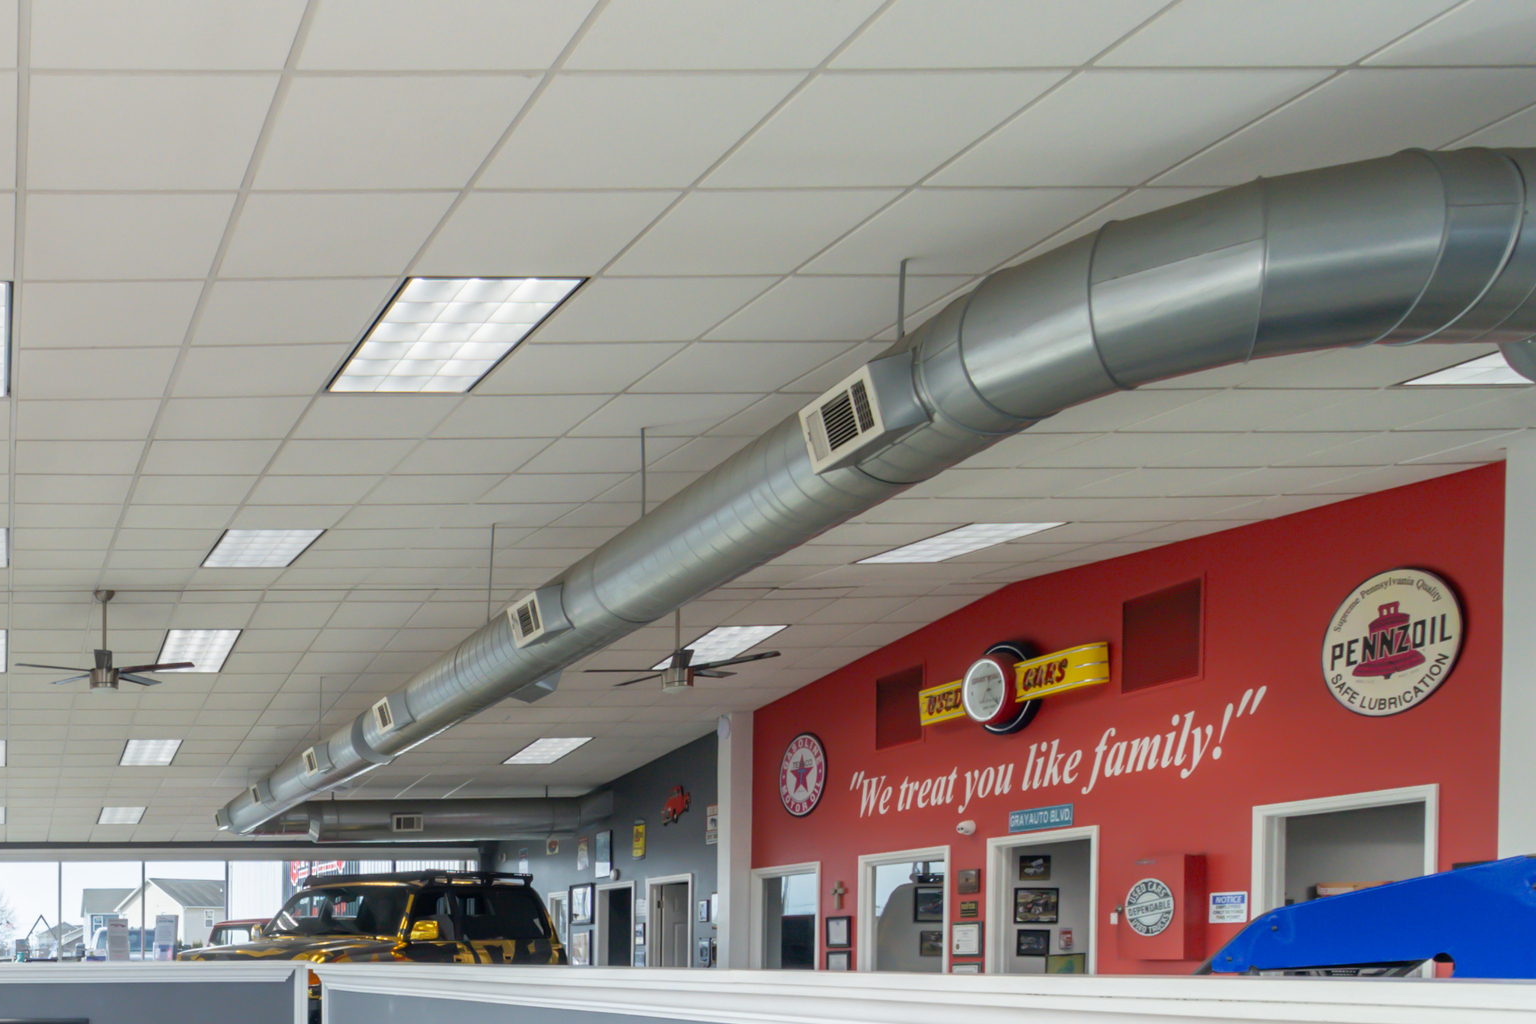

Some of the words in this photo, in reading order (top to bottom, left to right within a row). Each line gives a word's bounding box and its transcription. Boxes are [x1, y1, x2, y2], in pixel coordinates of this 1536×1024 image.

[1333, 597, 1360, 632] Supreme
[1359, 576, 1414, 599] Pennsylvania
[1416, 578, 1442, 602] Quality
[1330, 613, 1452, 671] PENNZOIL
[926, 688, 962, 716] USED
[1022, 658, 1069, 692] CARS
[1331, 673, 1360, 704] SAFE
[1359, 653, 1450, 710] LUBRICATION
[784, 738, 822, 770] GASOLINE
[897, 766, 959, 811] treat
[957, 762, 1014, 814] you
[1021, 738, 1083, 792] like
[781, 785, 808, 812] MOTOR
[809, 783, 822, 802] OIL
[1128, 899, 1171, 917] DEPENDABLE
[1129, 883, 1146, 904] USED
[1147, 881, 1166, 898] CARS
[1214, 895, 1242, 904] NOTICE
[1148, 913, 1170, 934] TRUCKS
